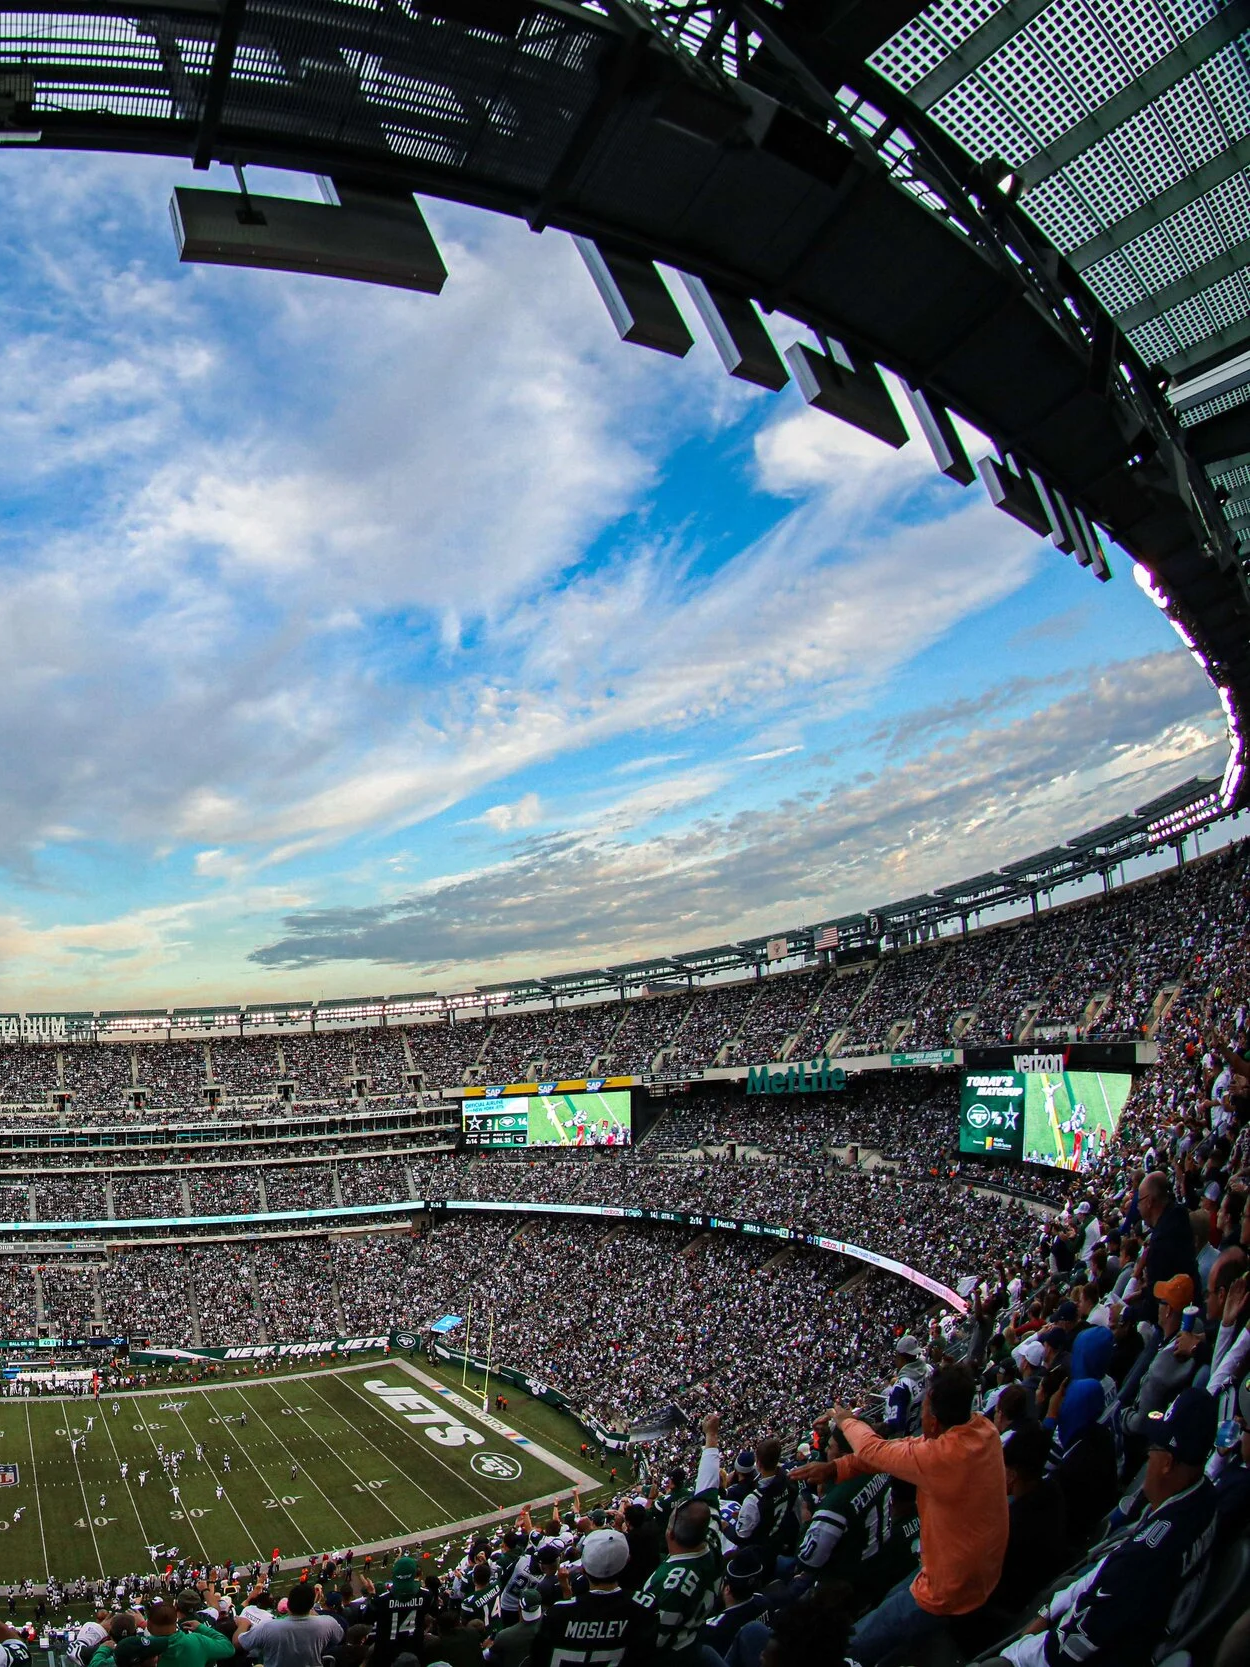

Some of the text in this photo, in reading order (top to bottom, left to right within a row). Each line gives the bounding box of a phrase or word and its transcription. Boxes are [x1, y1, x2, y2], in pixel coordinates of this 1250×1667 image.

[1013, 1049, 1064, 1073] verizon
[746, 1057, 846, 1095] MetLife
[966, 1076, 1014, 1087] TODAY'S
[485, 1088, 500, 1097] SAP
[538, 1084, 553, 1093] SAP
[586, 1082, 601, 1091] SAP
[976, 1087, 1023, 1097] MATCHUP
[486, 1119, 492, 1127] 3
[517, 1118, 527, 1126] 14
[689, 1216, 703, 1225] 2:14
[717, 1220, 736, 1229] MetLife
[224, 1336, 390, 1359] NEW YORK JETS
[363, 1380, 485, 1447] JETS
[479, 1456, 513, 1477] JETS
[352, 1480, 382, 1492] 10
[851, 1472, 893, 1515] PENNIN
[262, 1496, 296, 1509] 20
[170, 1508, 204, 1520] 30
[73, 1517, 109, 1528] 40
[663, 1567, 700, 1597] 85
[474, 1585, 500, 1608] DARNOLD
[389, 1597, 424, 1609] DARNOLD
[482, 1596, 500, 1626] 14
[390, 1611, 417, 1640] 14
[565, 1620, 629, 1639] MOSLEY
